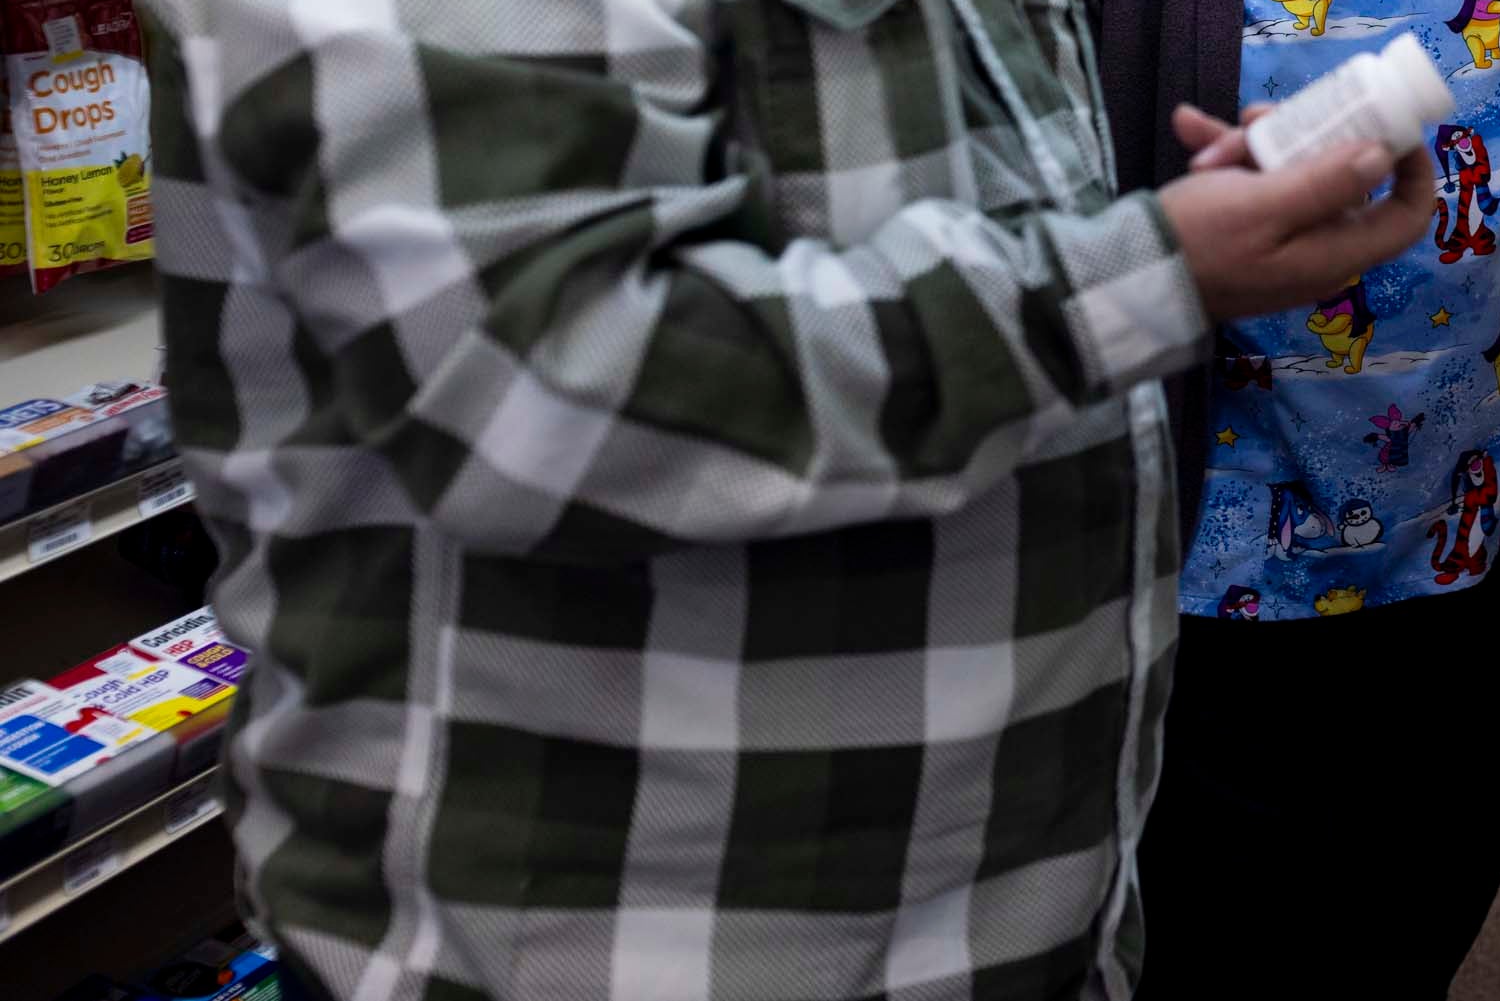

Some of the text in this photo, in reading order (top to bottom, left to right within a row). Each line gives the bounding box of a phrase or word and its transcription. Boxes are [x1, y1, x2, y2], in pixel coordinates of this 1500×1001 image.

[29, 62, 115, 98] Cough
[32, 100, 115, 135] Drops
[41, 167, 113, 188] Honey Lemon
[142, 614, 211, 648] Coricidin
[164, 640, 193, 657] HBP
[105, 685, 140, 704] Cold
